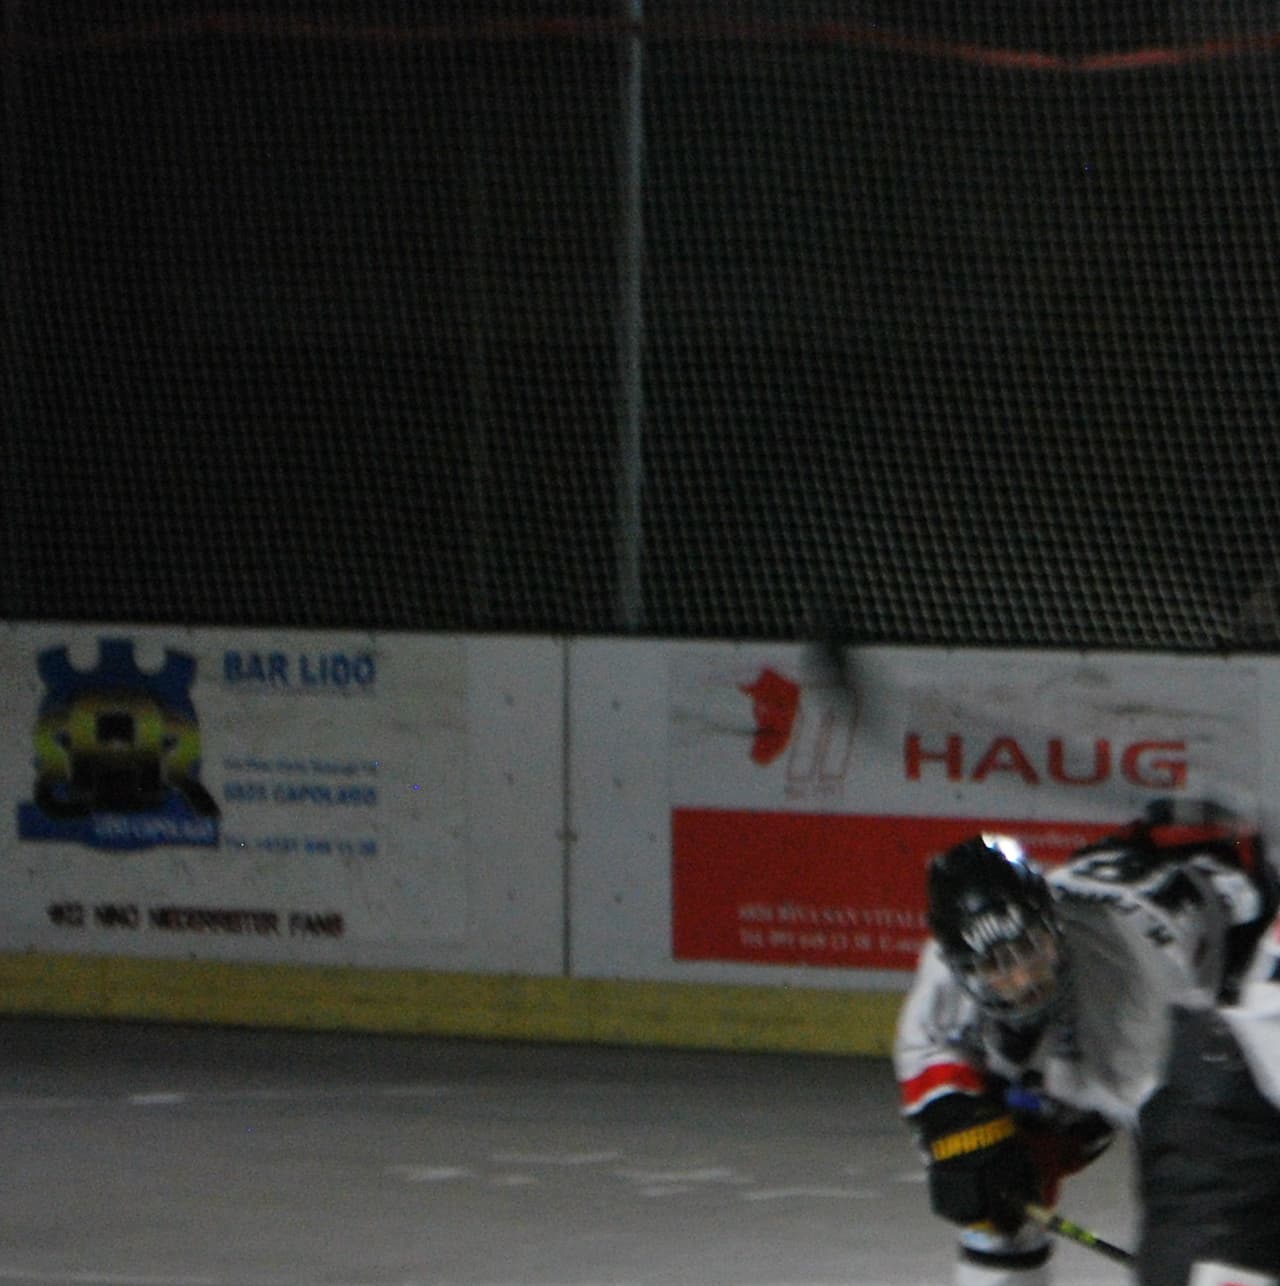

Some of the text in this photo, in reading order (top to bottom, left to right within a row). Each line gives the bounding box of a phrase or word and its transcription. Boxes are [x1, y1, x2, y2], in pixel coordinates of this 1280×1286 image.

[224, 650, 376, 687] BAR LIDO
[903, 731, 1188, 789] HAUG
